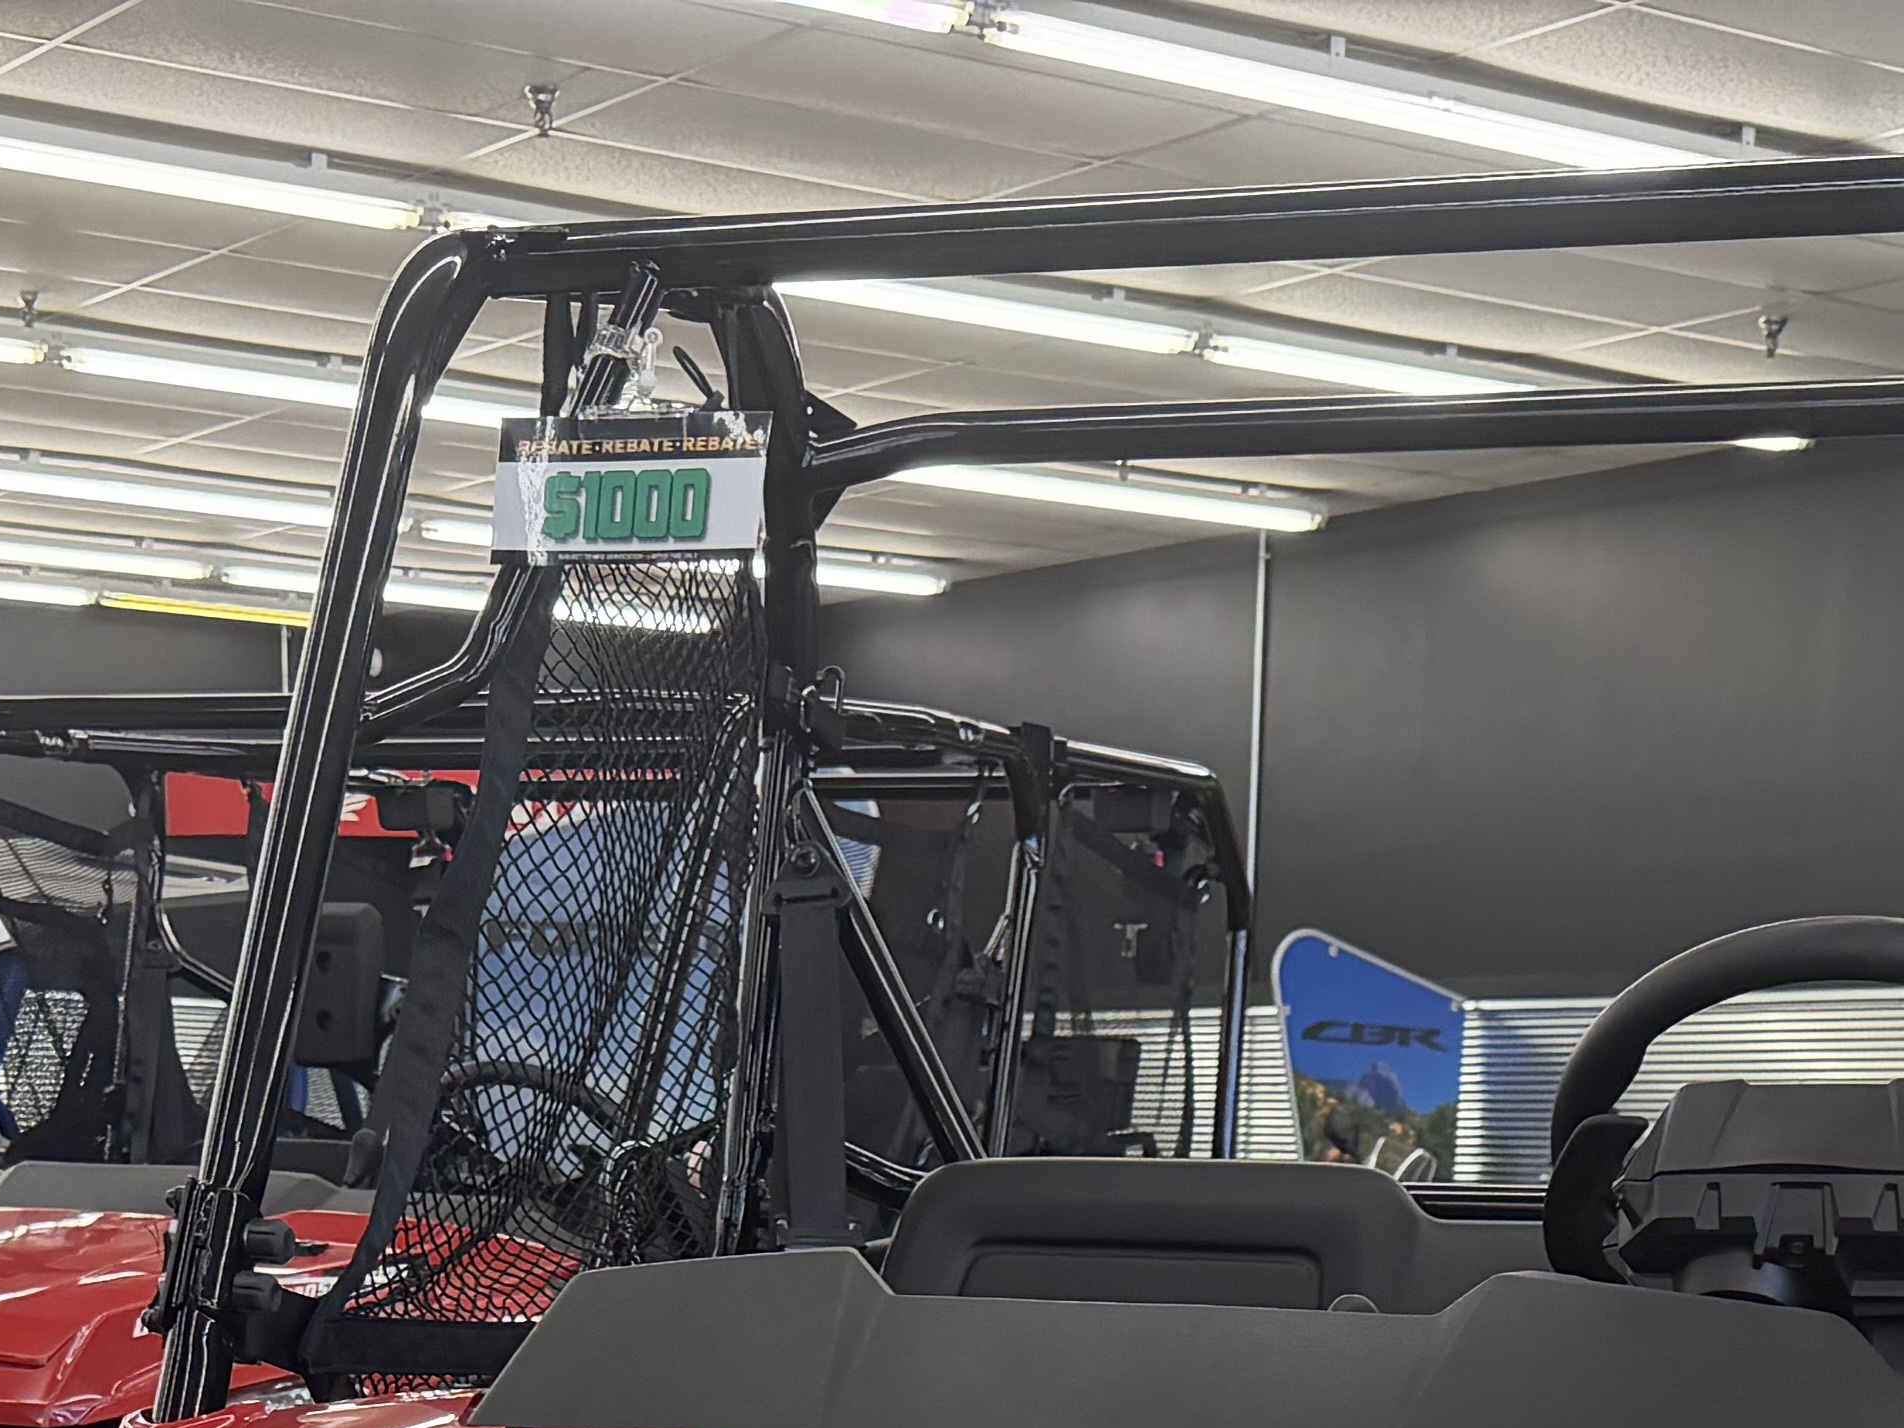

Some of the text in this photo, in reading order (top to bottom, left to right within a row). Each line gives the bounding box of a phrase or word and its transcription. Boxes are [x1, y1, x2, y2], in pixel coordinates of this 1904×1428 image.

[599, 437, 675, 457] REBATE
[542, 467, 712, 543] $1000
[1302, 1020, 1447, 1053] CBR
